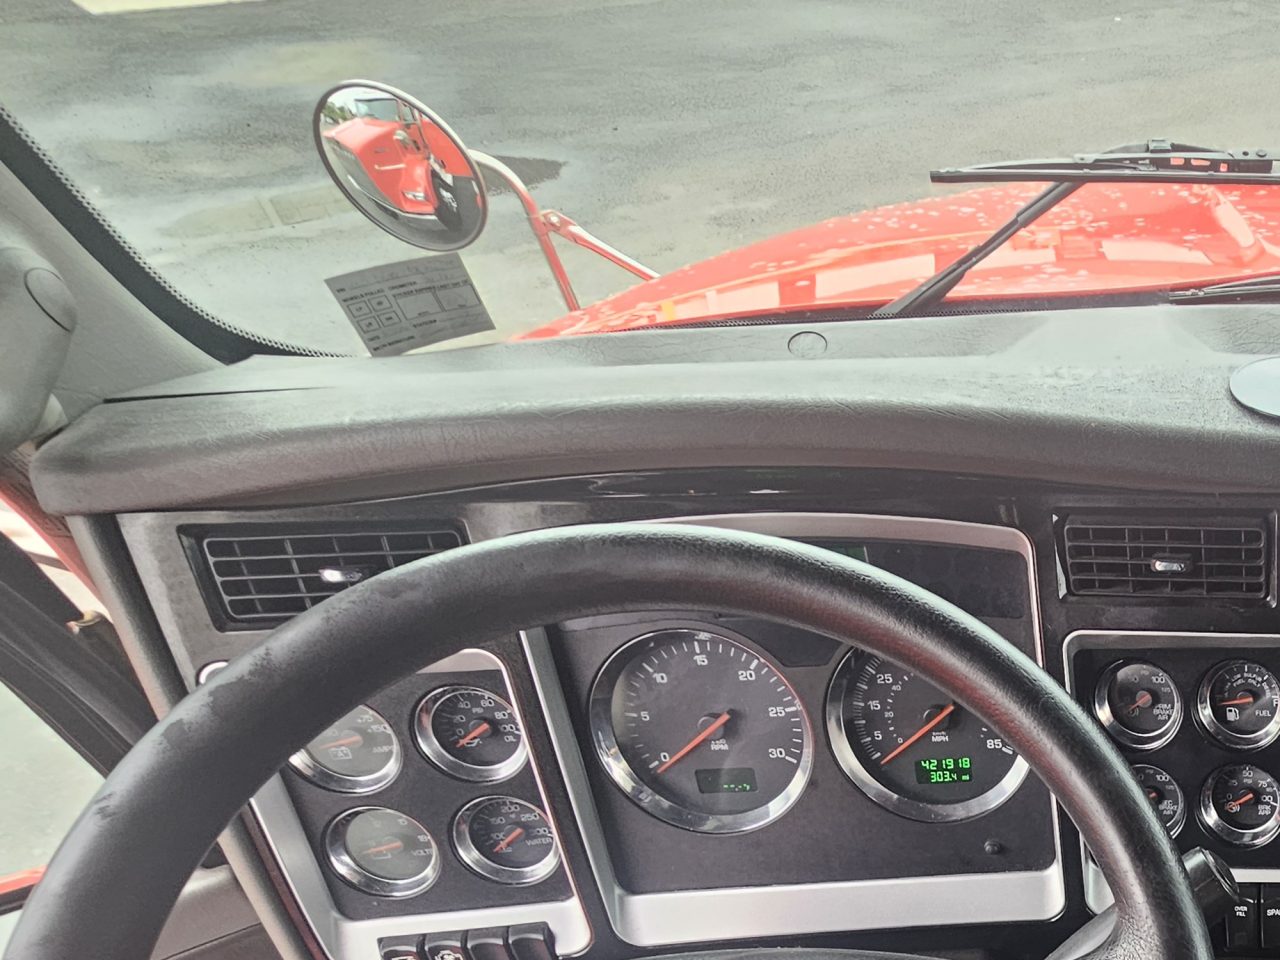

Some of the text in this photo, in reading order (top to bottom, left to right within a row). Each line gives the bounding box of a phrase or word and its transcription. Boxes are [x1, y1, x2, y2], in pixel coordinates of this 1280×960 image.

[693, 655, 708, 666] 15
[653, 672, 668, 684] 10
[738, 670, 755, 681] 20
[877, 674, 893, 684] 25
[1151, 676, 1165, 684] 100
[480, 699, 495, 707] 60
[868, 701, 881, 710] 15
[494, 711, 508, 720] 80
[641, 711, 650, 721] 5
[768, 707, 785, 717] 25
[456, 728, 464, 736] 0
[874, 731, 883, 741] 5
[932, 735, 949, 743] MPH
[986, 739, 1002, 749] 85
[660, 752, 669, 762] 0
[768, 748, 785, 758] 30
[921, 757, 971, 770] 421918
[930, 771, 957, 783] 303.4
[525, 837, 552, 846] WATER
